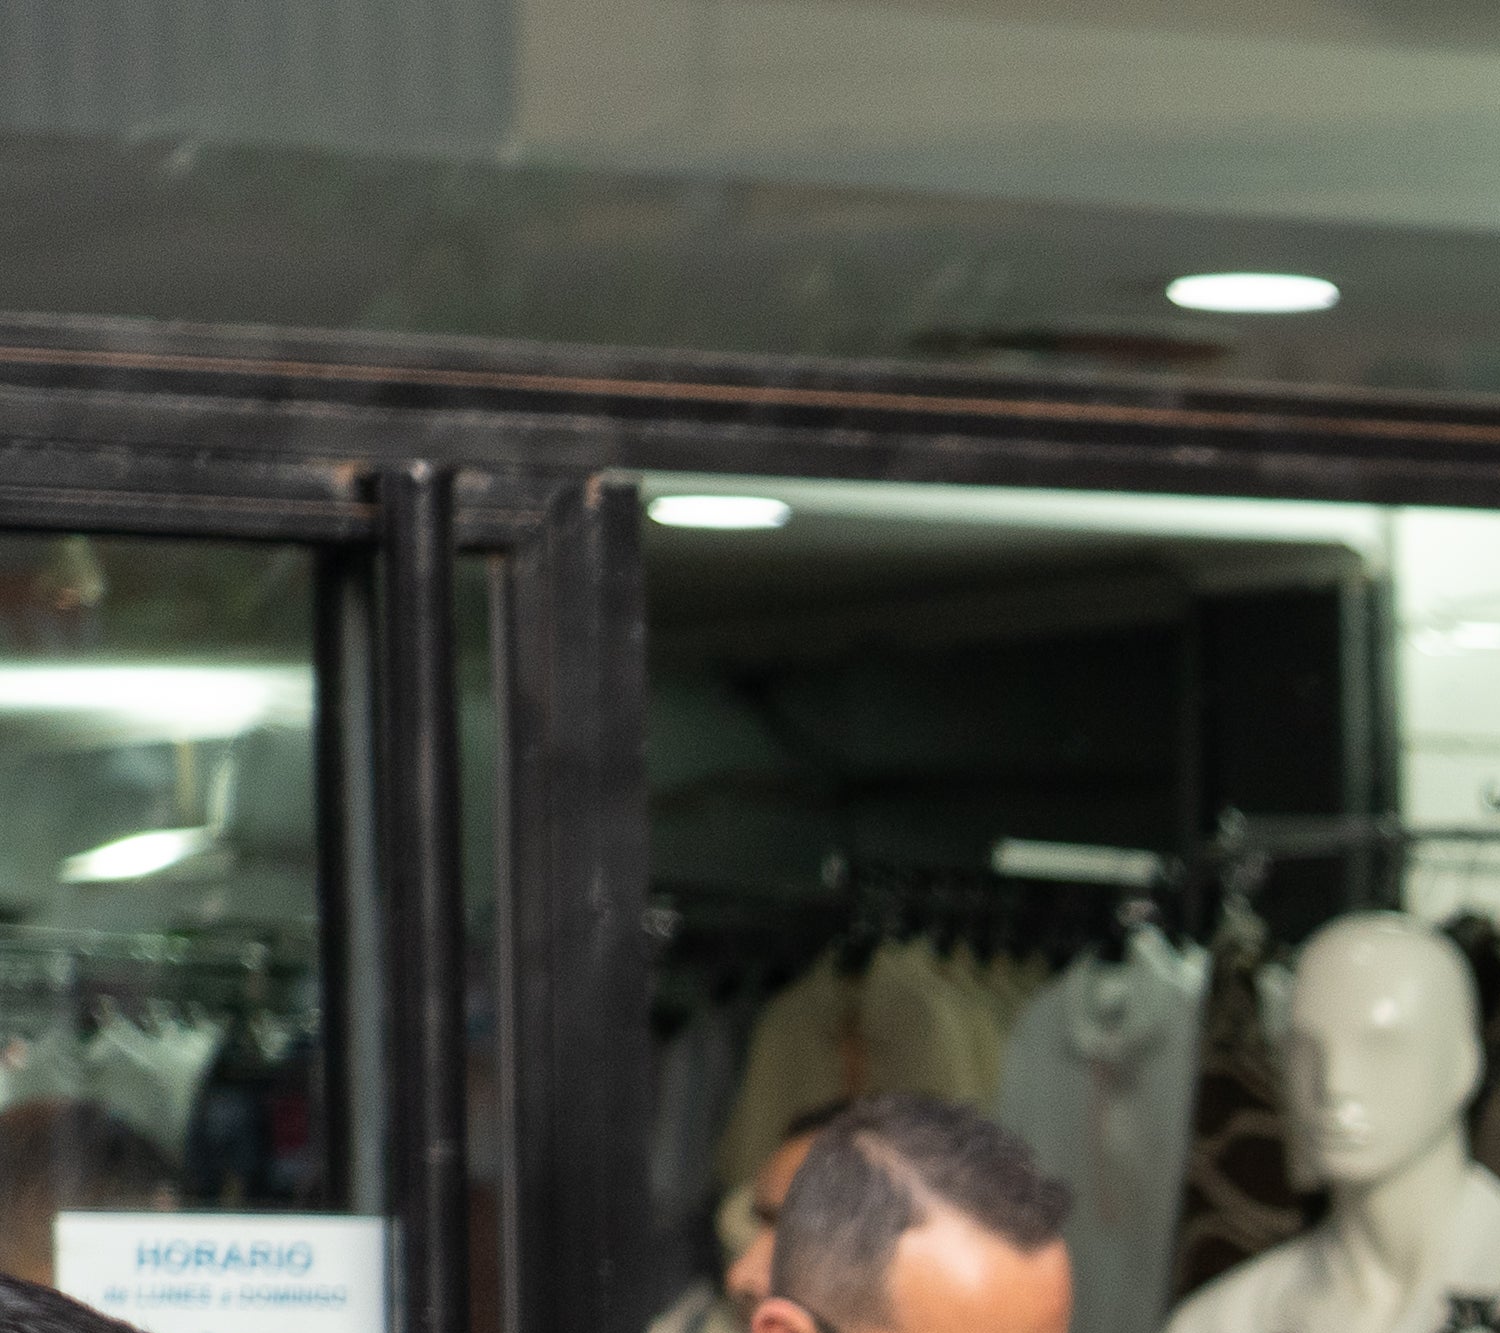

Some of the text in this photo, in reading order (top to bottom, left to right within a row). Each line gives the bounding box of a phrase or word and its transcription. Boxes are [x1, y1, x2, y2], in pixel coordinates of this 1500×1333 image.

[135, 1240, 314, 1275] HORARIO
[136, 1284, 212, 1308] LUNES
[238, 1284, 348, 1309] DOMINGO
